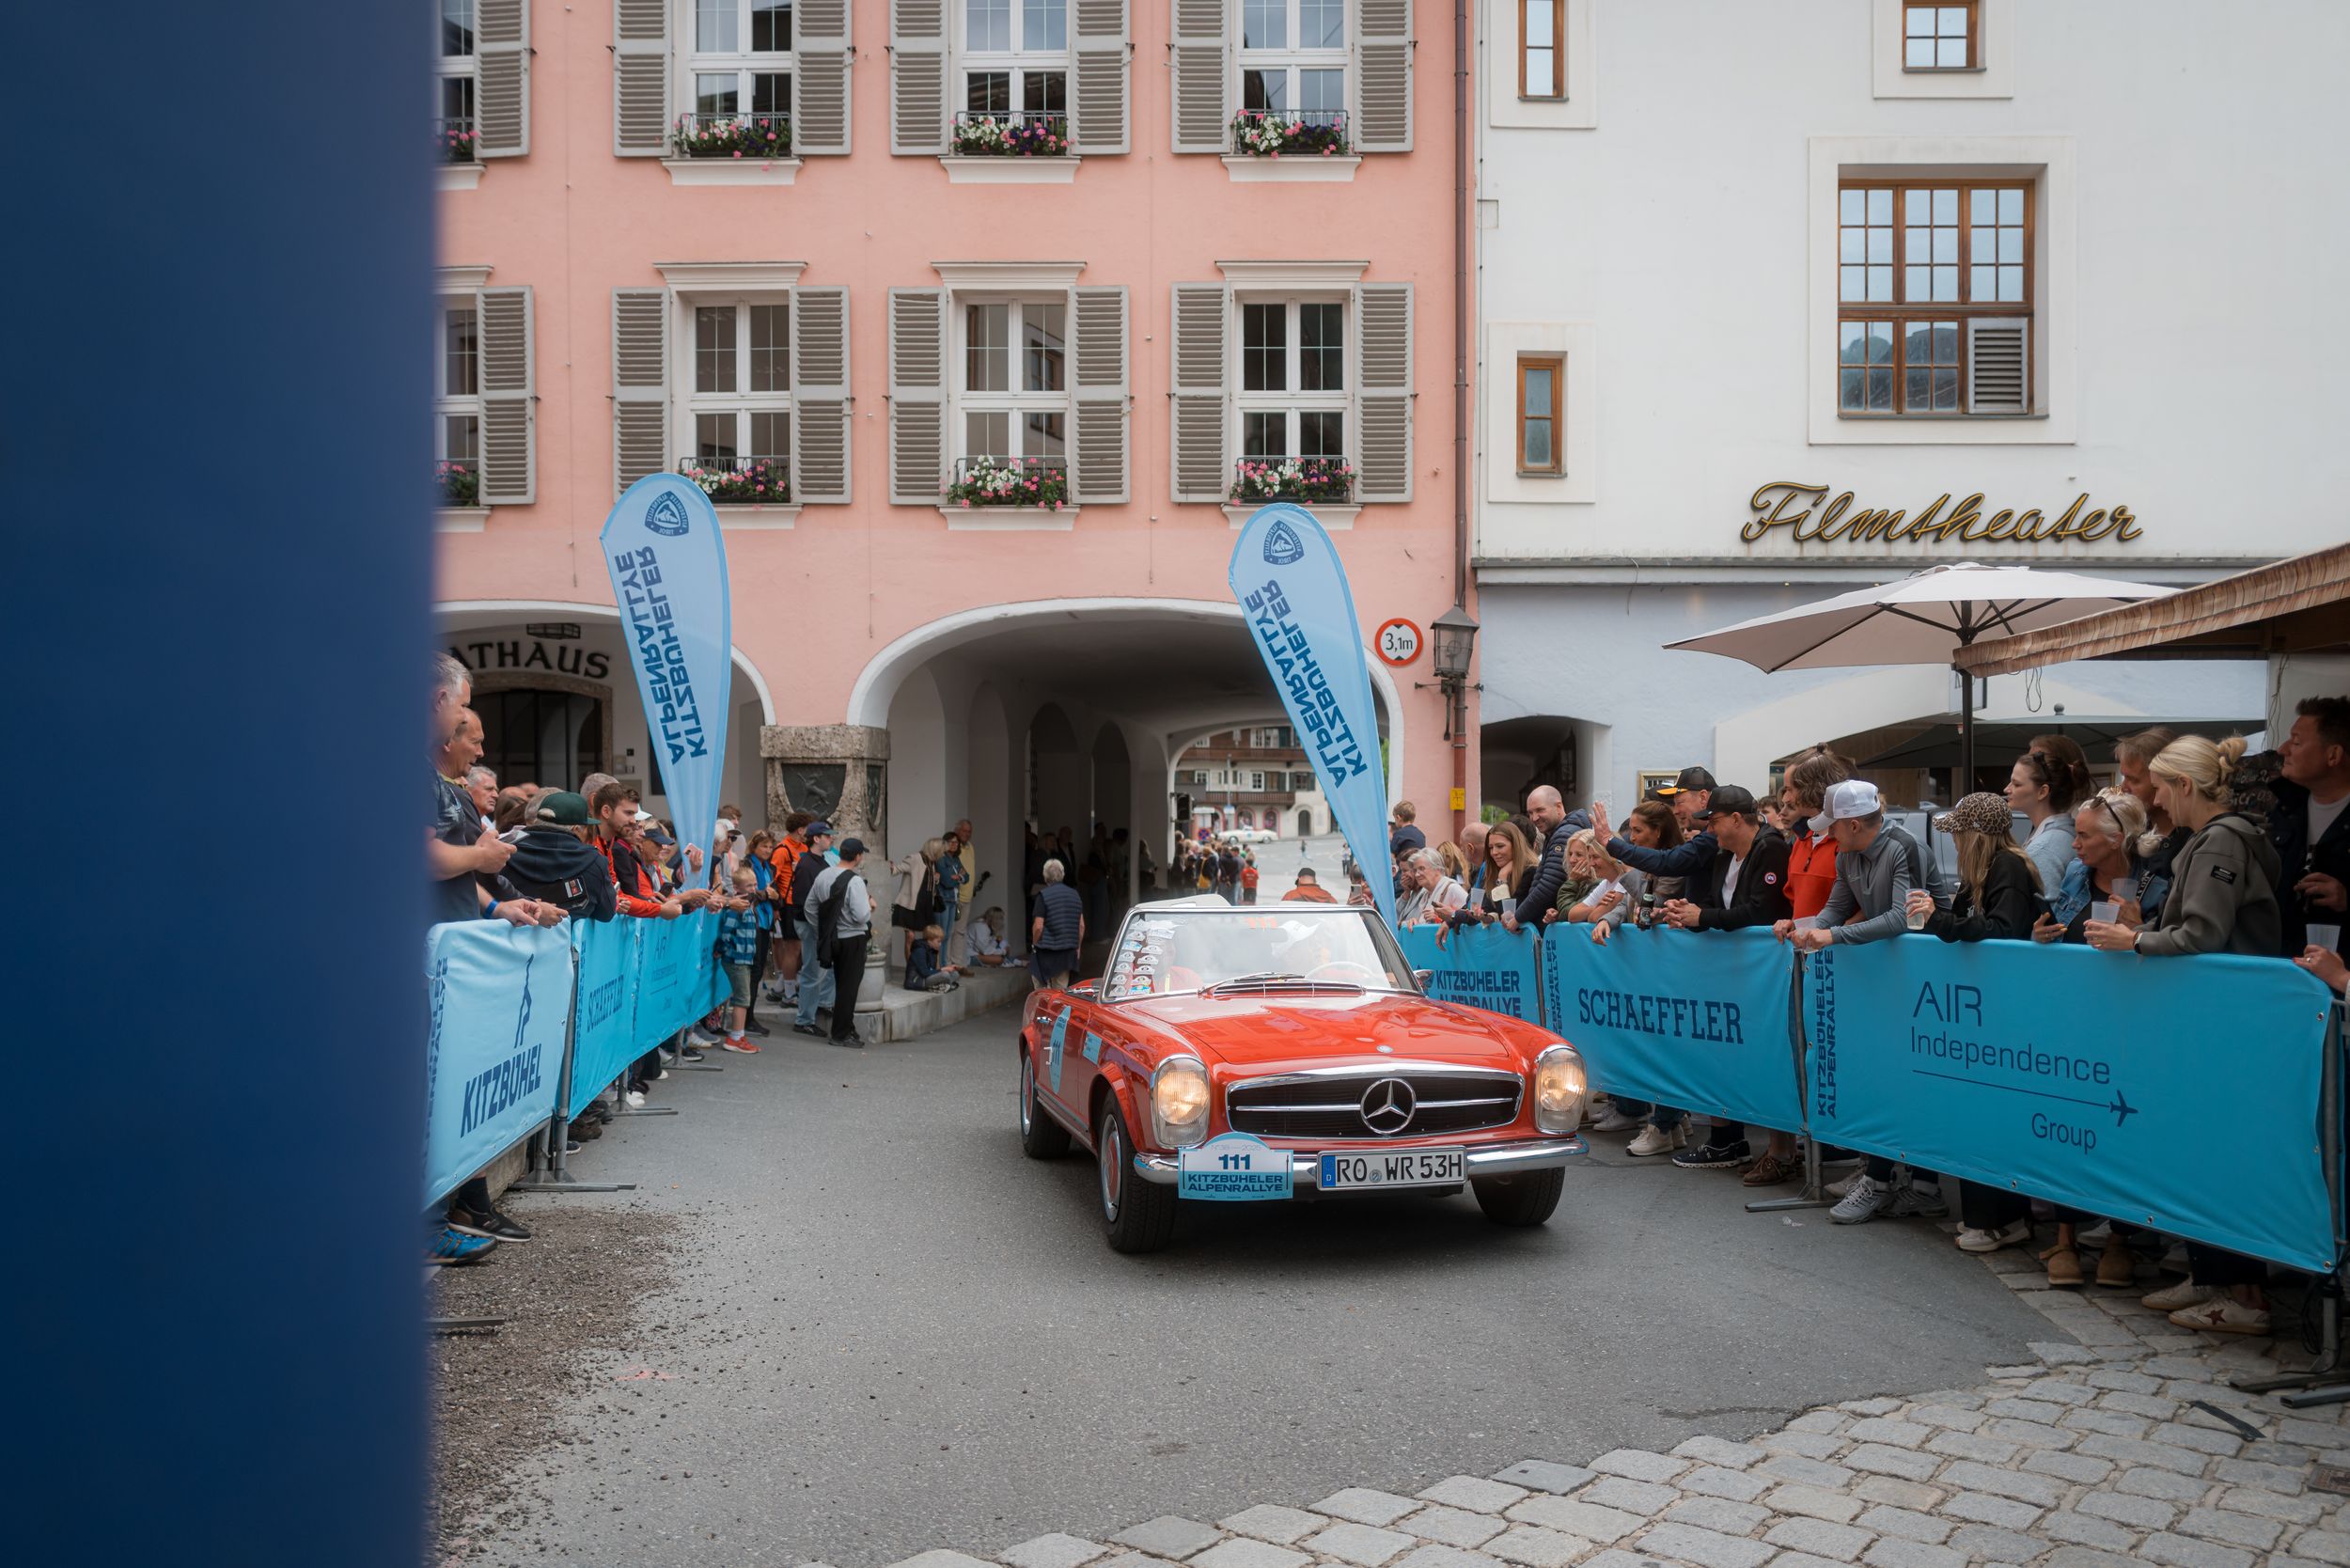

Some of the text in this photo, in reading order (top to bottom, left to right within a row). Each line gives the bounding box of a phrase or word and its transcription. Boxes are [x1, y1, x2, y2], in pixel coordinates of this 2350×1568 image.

[1740, 480, 2143, 542] Filmtheater
[449, 641, 610, 679] ATHAUS
[1386, 633, 1413, 652] 3,1m
[1435, 969, 1520, 993] KITZBÜHELER
[1546, 940, 1559, 1034] ZBÜHELER
[1551, 940, 1562, 1036] PENRALLYE
[1578, 987, 1744, 1044] SCHAEFFLER
[1913, 980, 1982, 1027] AIR
[1814, 950, 1826, 1116] KITZBÜHELER
[1825, 949, 1836, 1120] ALPENRALLYE
[1911, 1026, 2110, 1085] Independence
[2031, 1113, 2096, 1154] Group
[1188, 1173, 1283, 1184] KITZBÜHELER
[1218, 1154, 1250, 1169] 111
[1337, 1154, 1462, 1183] RO WR 53H
[1188, 1184, 1282, 1192] ALPENRALLYE
